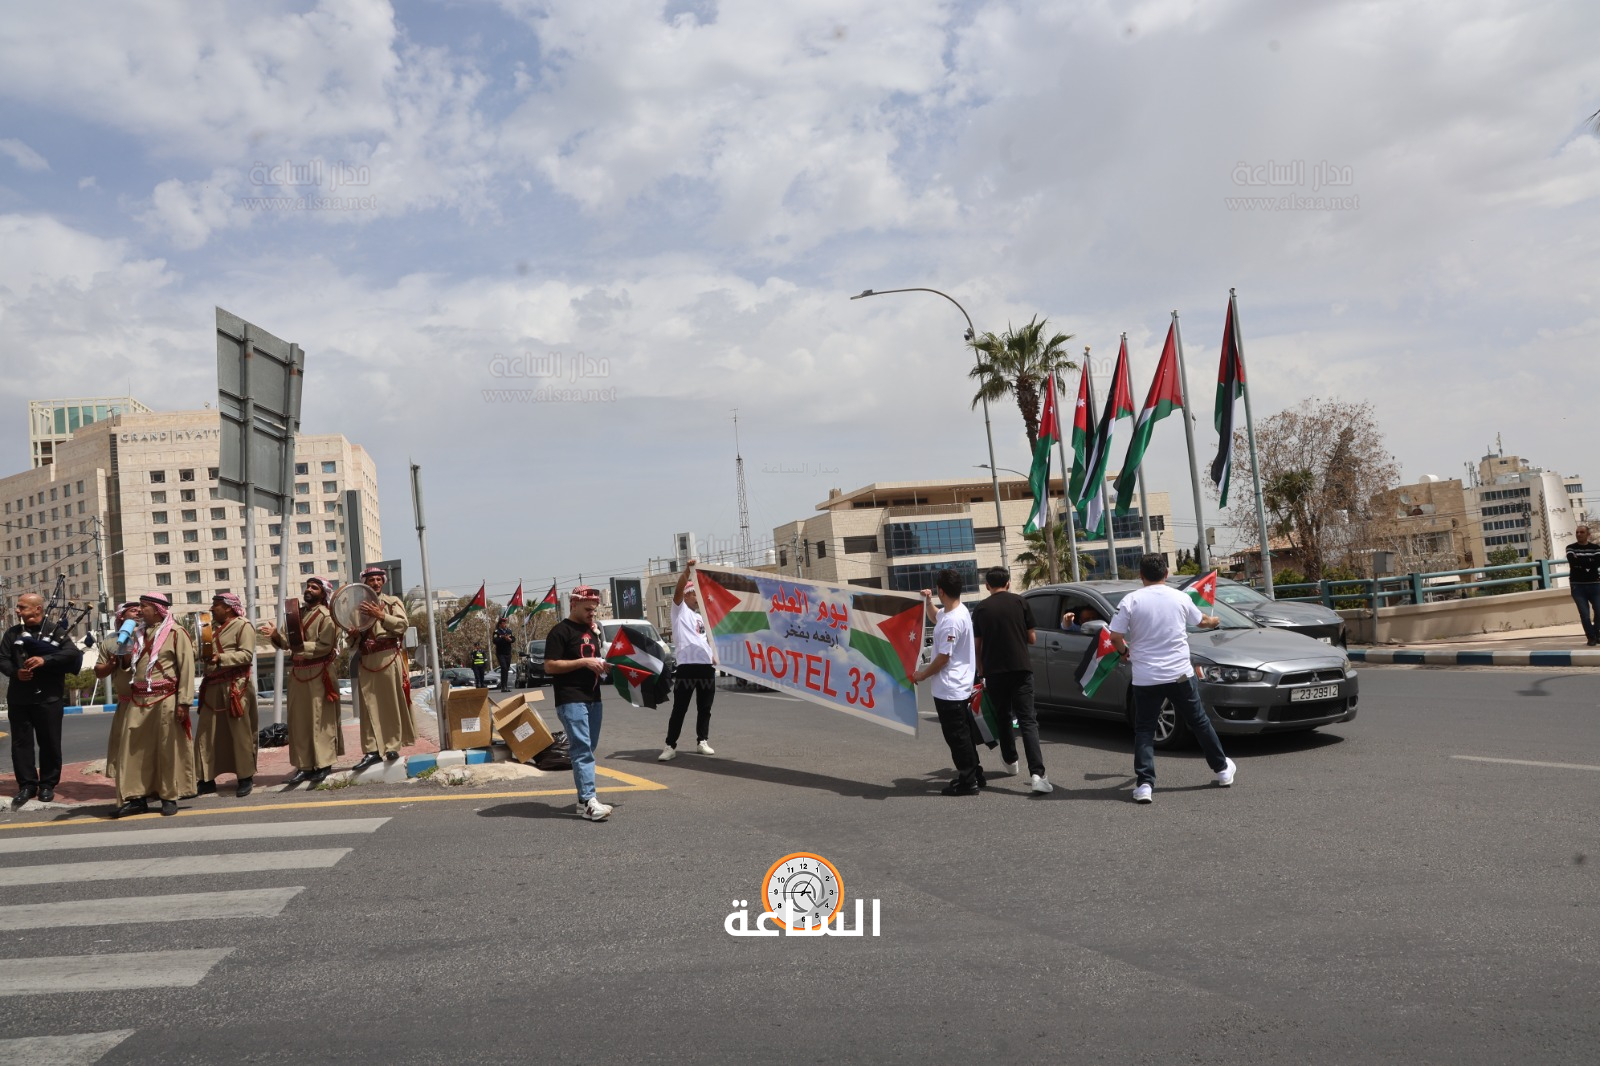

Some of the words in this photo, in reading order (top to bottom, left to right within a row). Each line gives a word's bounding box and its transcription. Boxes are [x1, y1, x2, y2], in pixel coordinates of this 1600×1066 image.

[120, 432, 168, 443] GRAND
[175, 429, 219, 440] HYATT
[769, 584, 809, 614] العلم
[816, 601, 848, 631] يوم
[784, 624, 809, 643] بفخر
[745, 640, 837, 697] HOTEL
[846, 667, 876, 709] 33
